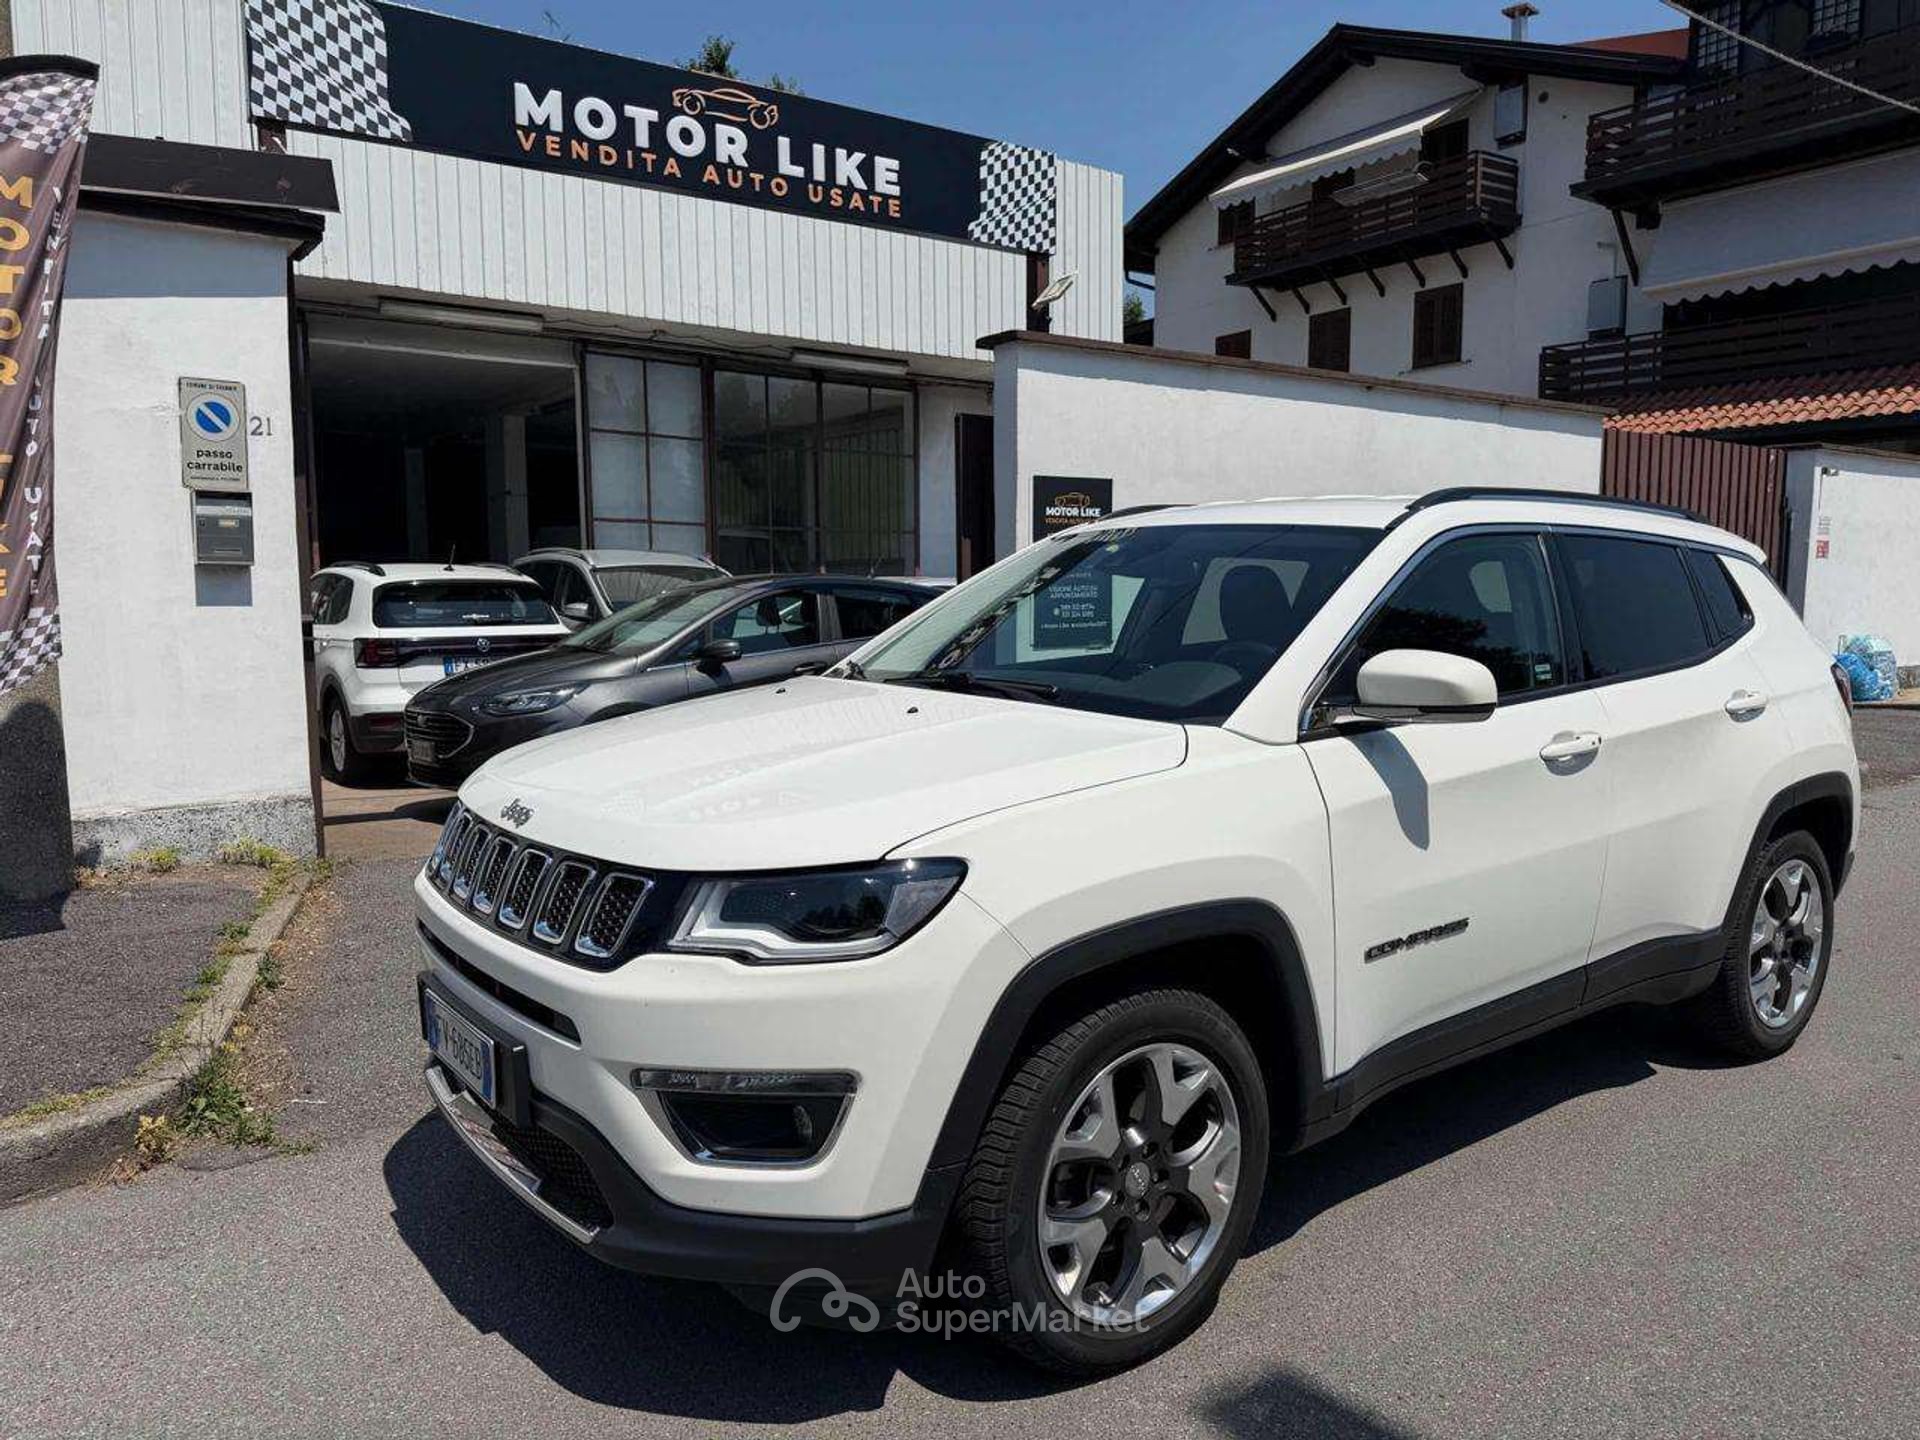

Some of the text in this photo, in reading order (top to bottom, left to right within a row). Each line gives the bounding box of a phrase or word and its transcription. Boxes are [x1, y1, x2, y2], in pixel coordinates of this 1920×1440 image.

[513, 82, 901, 196] MOTOR LIKE
[516, 129, 901, 217] VENDITA AUTO USATE
[249, 416, 272, 436] 21
[196, 449, 233, 458] passo
[186, 461, 243, 472] carrabile
[1045, 506, 1101, 517] MOTOR LIKE
[500, 798, 535, 829] Jeep
